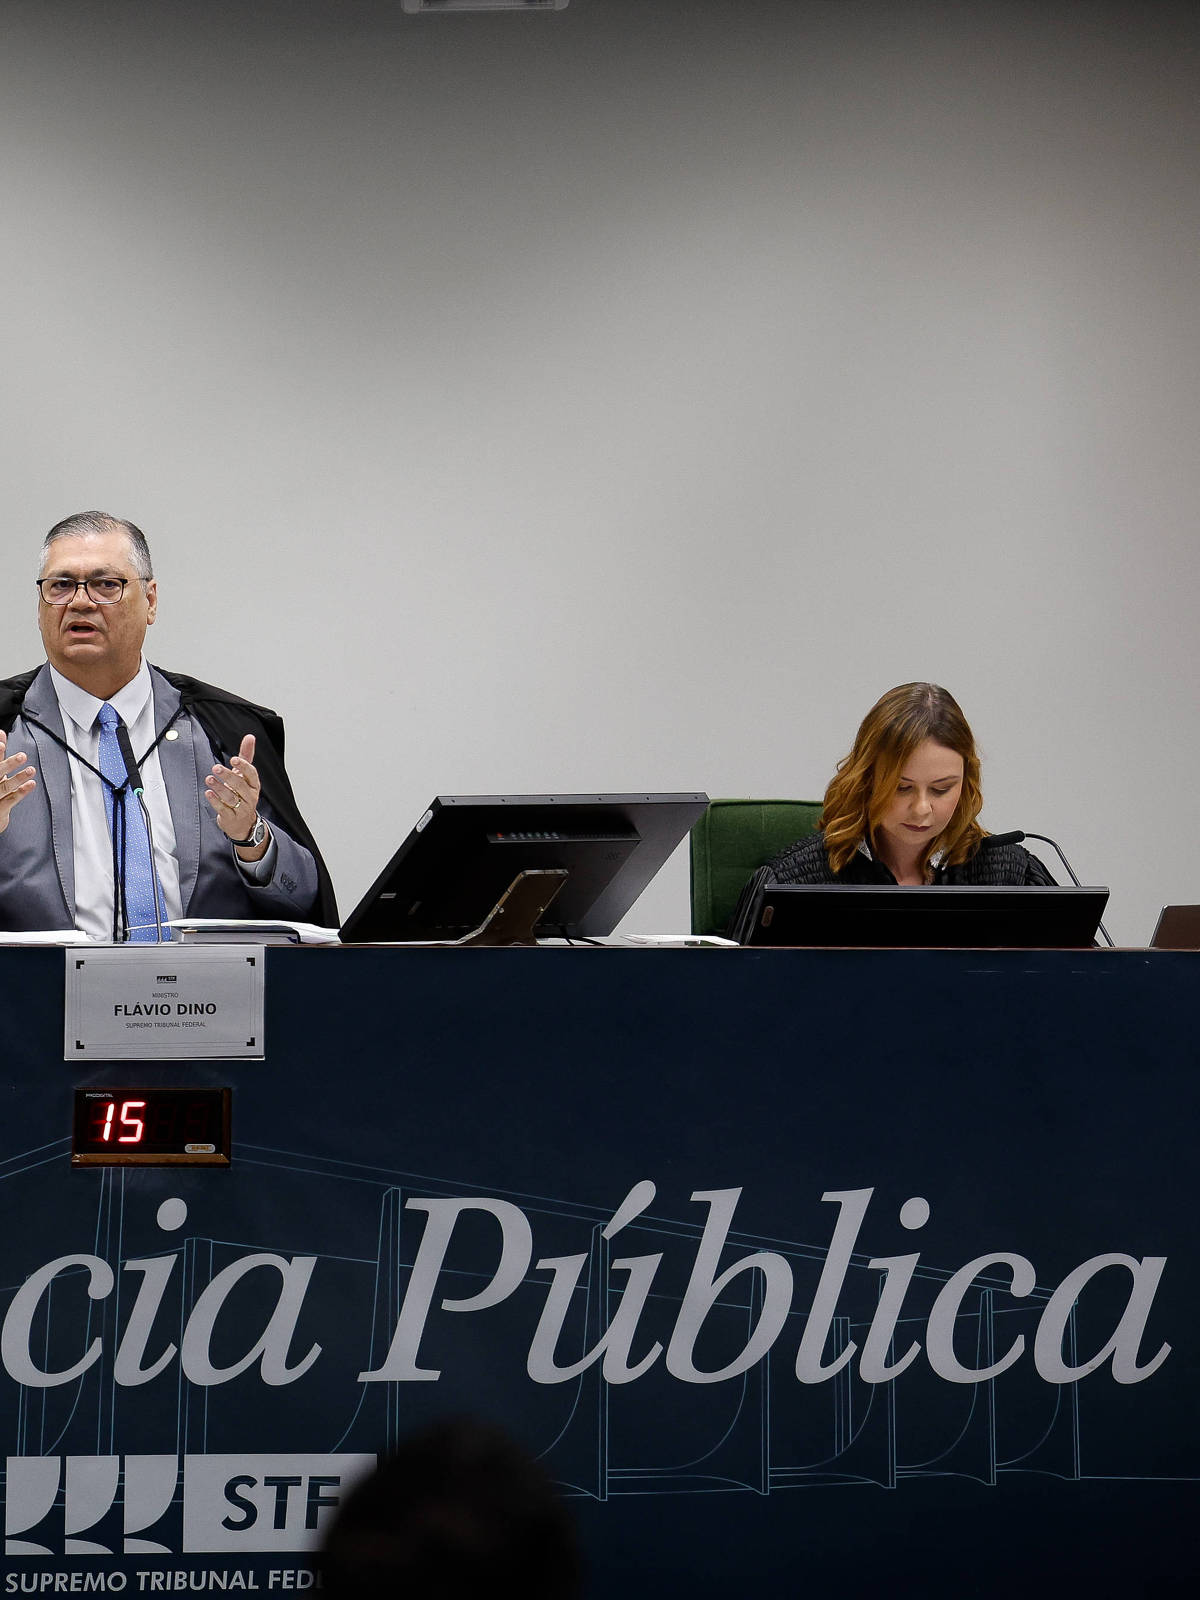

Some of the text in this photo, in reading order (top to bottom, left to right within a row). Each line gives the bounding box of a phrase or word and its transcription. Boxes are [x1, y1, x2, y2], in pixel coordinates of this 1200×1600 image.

[114, 1001, 217, 1016] FLÁVIO DINO
[103, 1101, 146, 1143] 15
[357, 1180, 1172, 1385] Pública
[220, 1475, 341, 1532] STF
[5, 1571, 127, 1593] SUPREMO
[136, 1570, 259, 1592] TRIBUNAL
